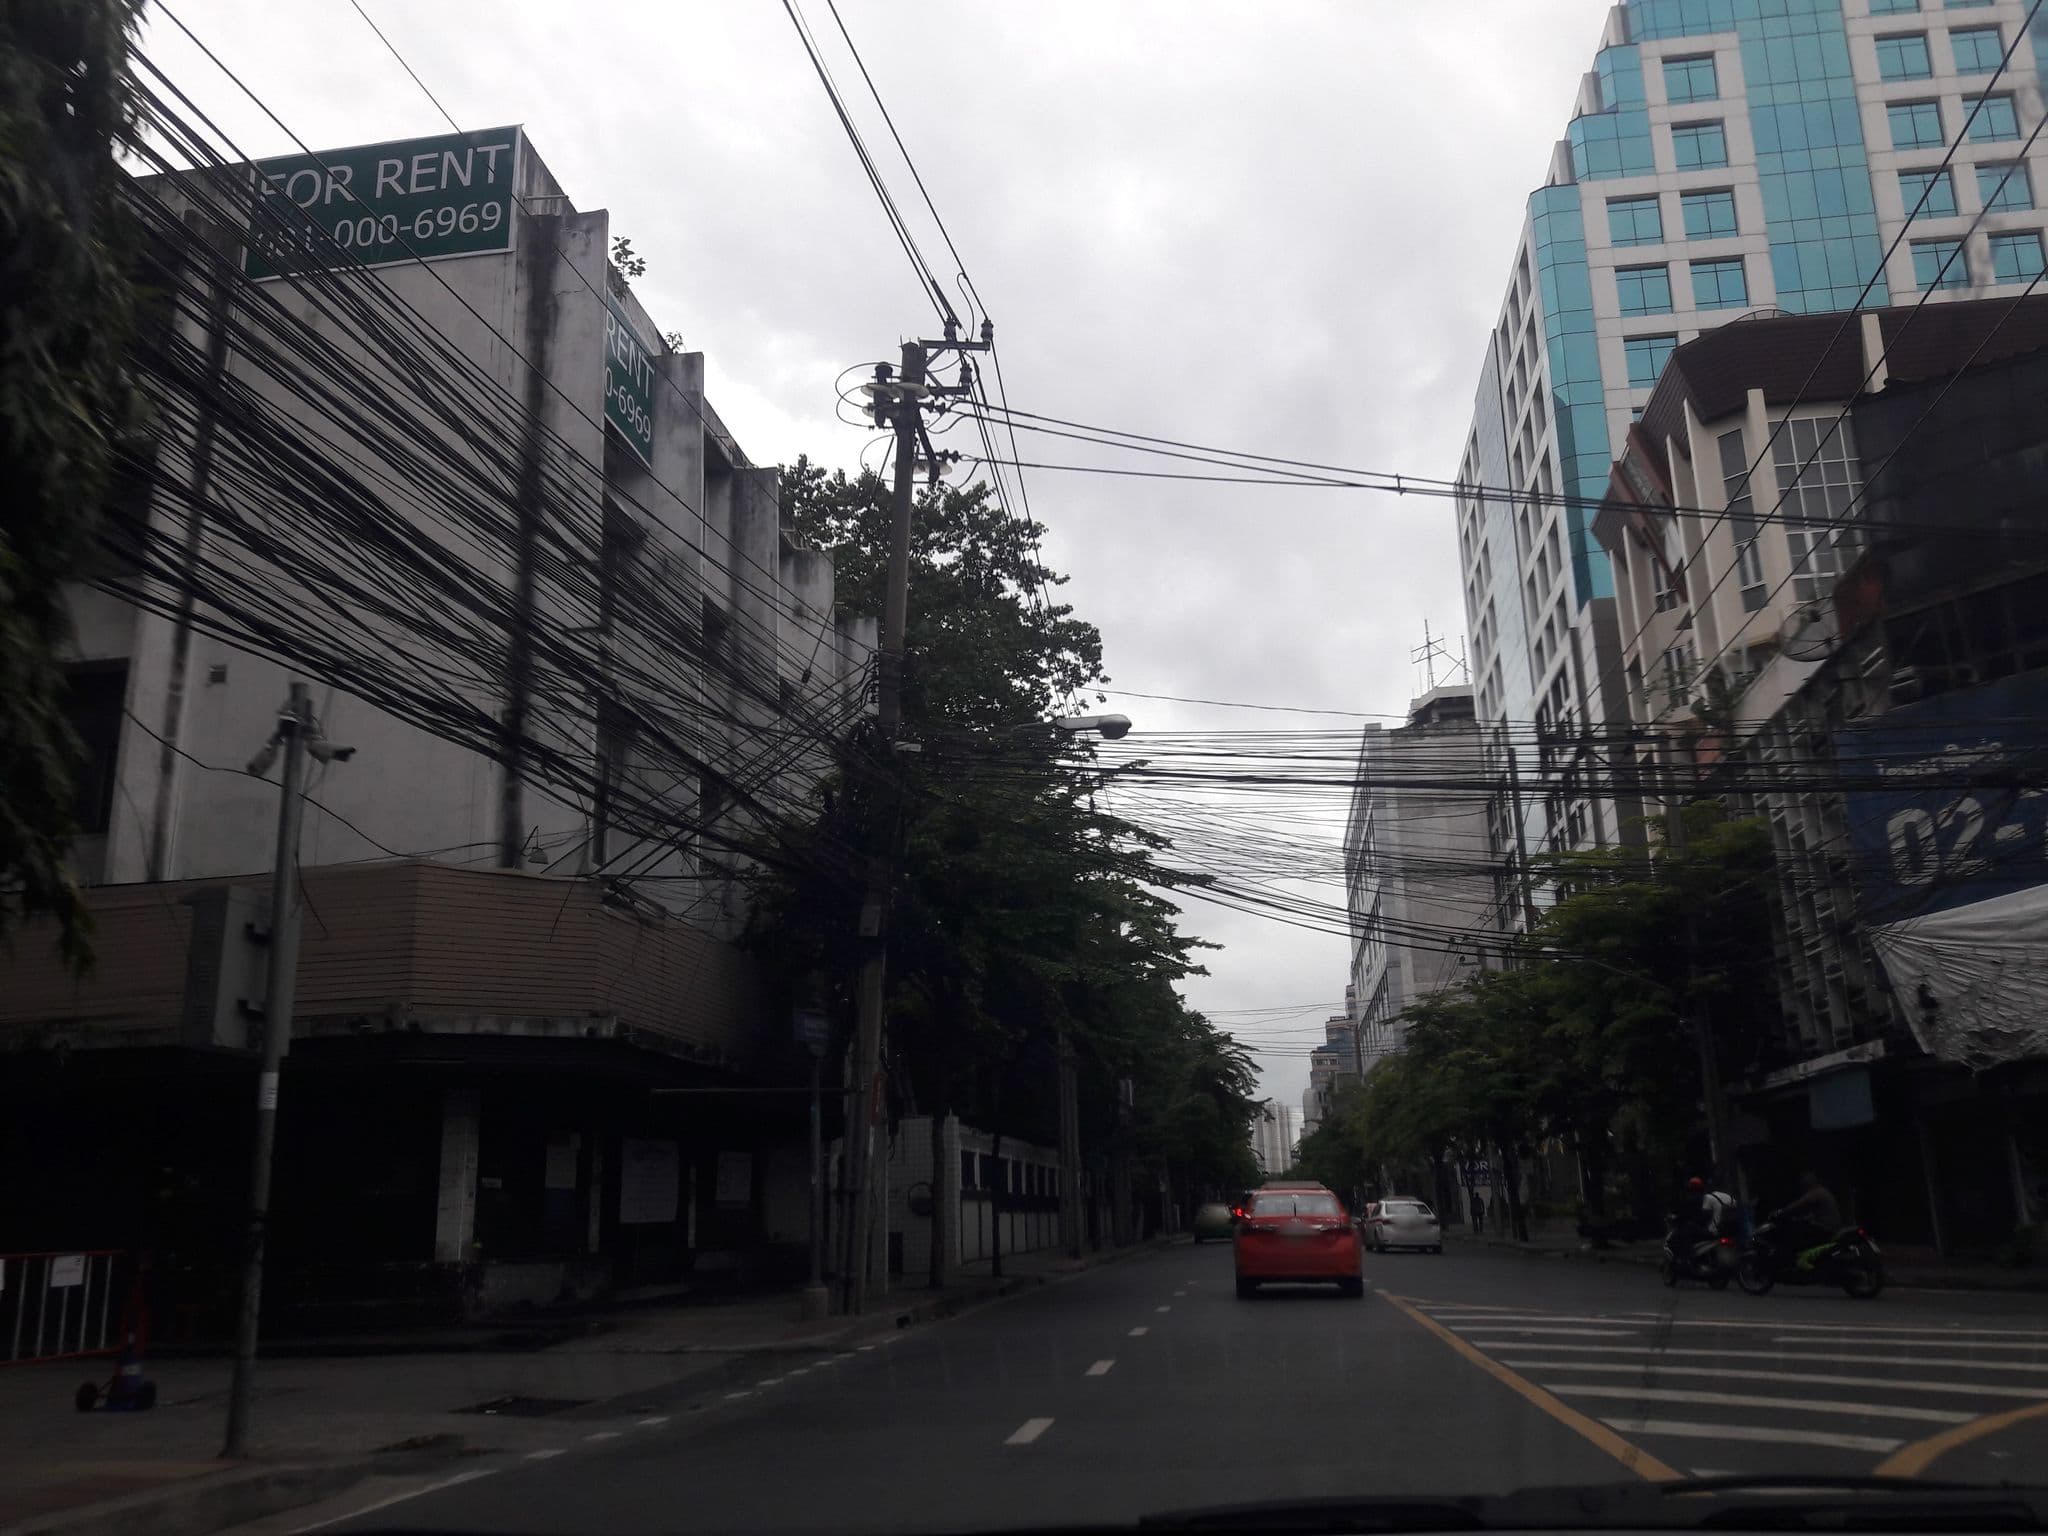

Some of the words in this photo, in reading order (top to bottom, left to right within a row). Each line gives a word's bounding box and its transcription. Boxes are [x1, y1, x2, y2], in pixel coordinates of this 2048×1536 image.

[259, 165, 357, 209] FOR
[375, 143, 510, 198] RENT
[606, 309, 655, 399] RENT
